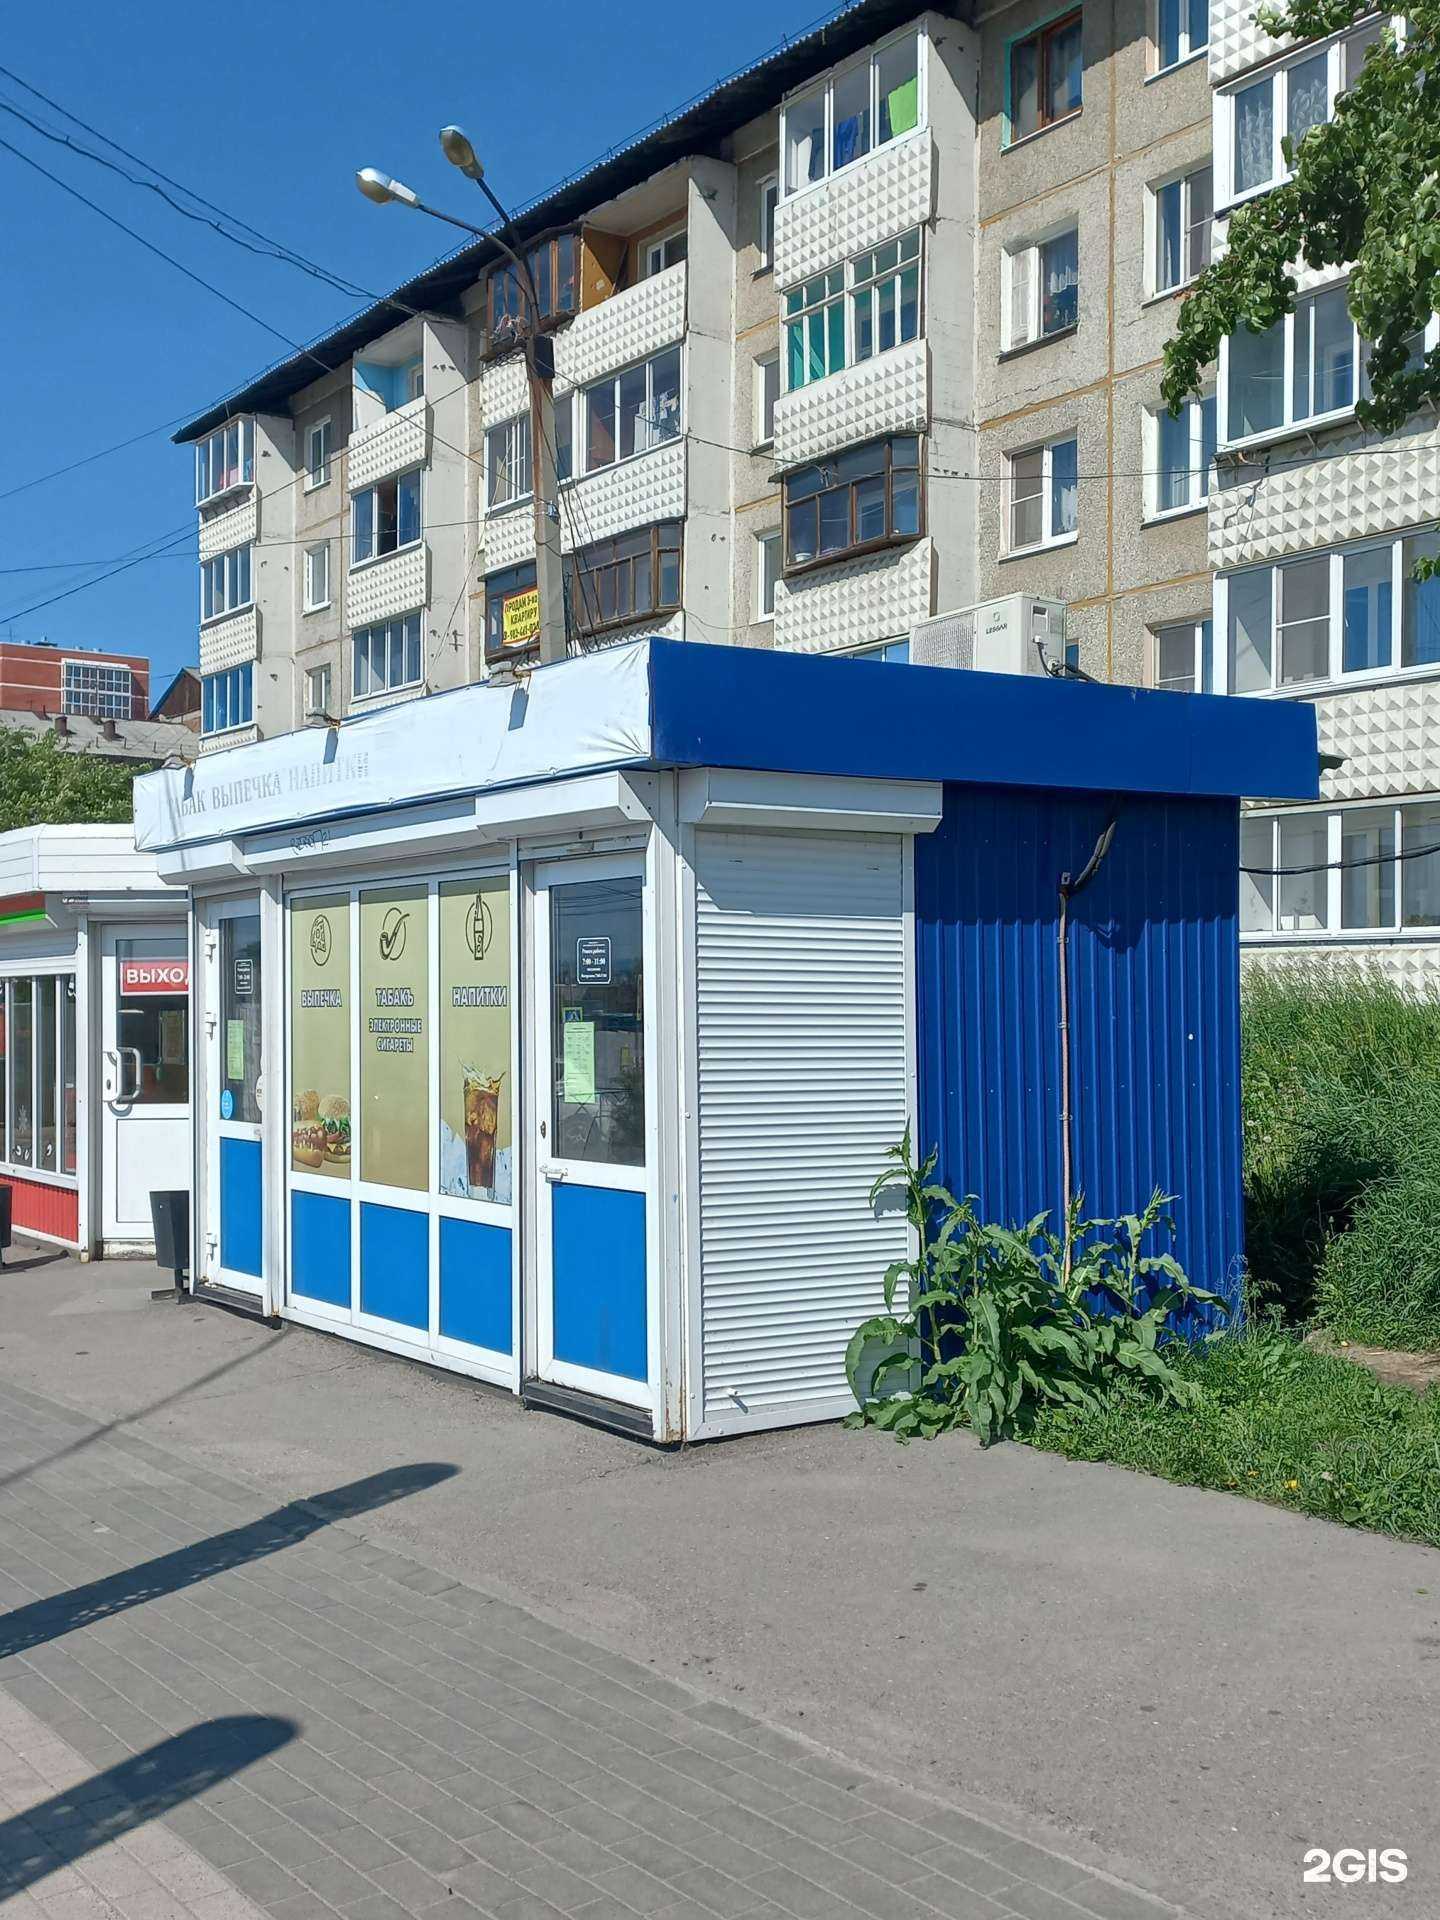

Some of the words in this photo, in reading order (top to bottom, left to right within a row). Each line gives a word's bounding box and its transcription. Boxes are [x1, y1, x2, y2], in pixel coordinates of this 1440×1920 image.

[505, 597, 527, 613] ПРОДАМ
[511, 607, 538, 625] КВАРТИРУ
[212, 772, 282, 810] ВЫПЕЧКА
[288, 752, 369, 792] НАПИТКИ
[126, 967, 190, 985] ВЫХО
[301, 989, 342, 1007] ВЫПЕЧКА
[375, 988, 414, 1006] ТАБАКЪ
[452, 986, 508, 1007] НАПИТКИ
[369, 1018, 422, 1033] ЭЛЕКТРОННЫЕ
[376, 1037, 414, 1052] СИГАРЕТЫ
